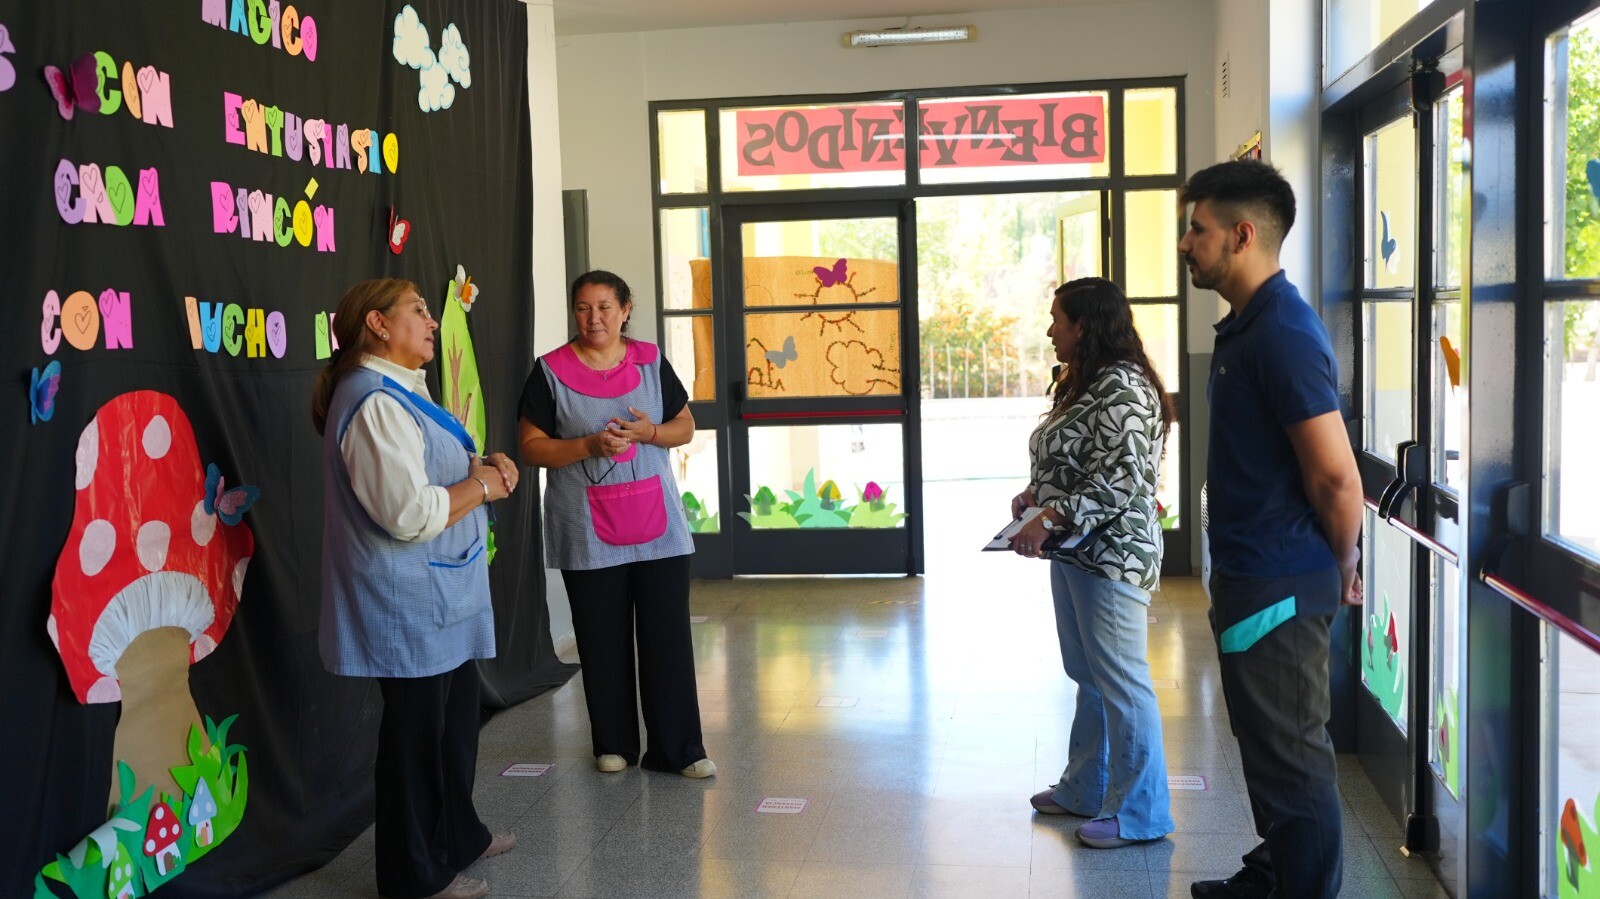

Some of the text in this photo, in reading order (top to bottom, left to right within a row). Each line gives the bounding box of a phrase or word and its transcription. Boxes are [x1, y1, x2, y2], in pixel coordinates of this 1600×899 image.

[94, 51, 174, 128] CON
[54, 159, 337, 252] CADA RINCÓN
[41, 288, 133, 355] CON
